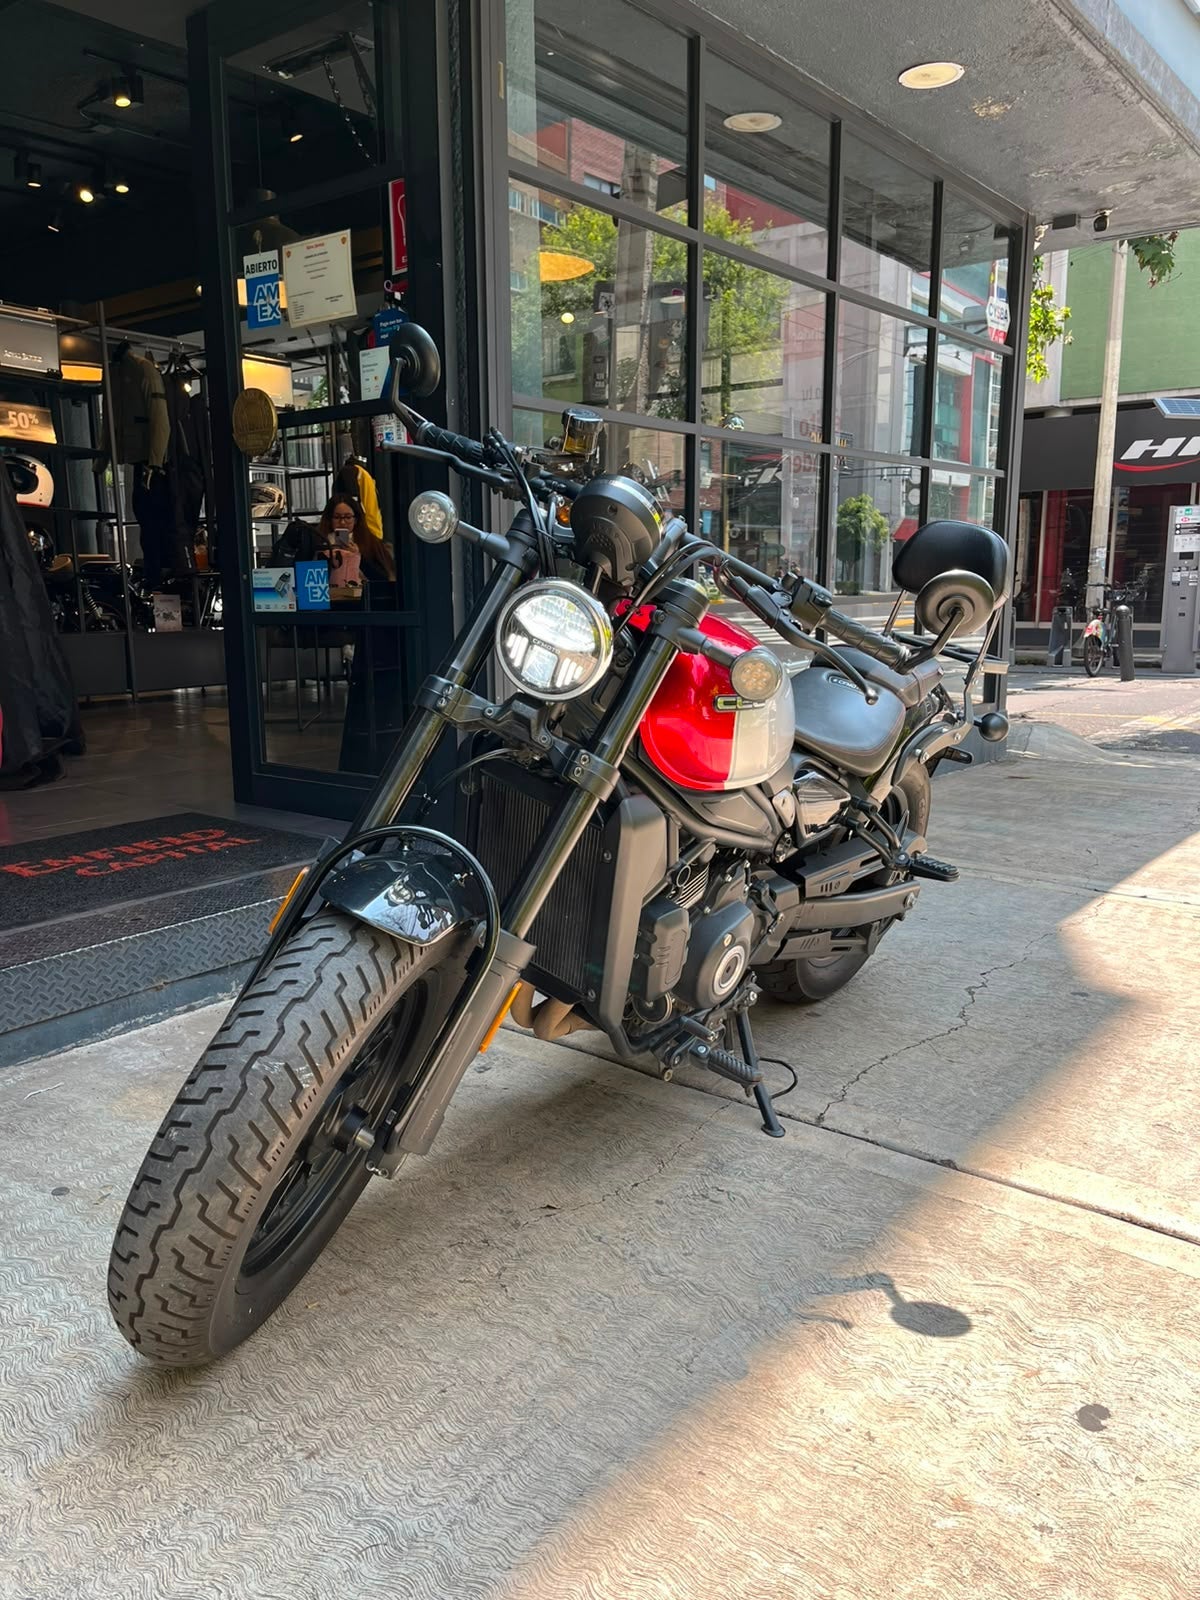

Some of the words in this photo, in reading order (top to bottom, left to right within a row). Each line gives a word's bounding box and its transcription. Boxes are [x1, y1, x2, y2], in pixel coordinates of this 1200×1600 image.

[245, 259, 278, 275] ABIERTO
[989, 303, 1008, 320] CYSBA
[8, 411, 39, 429] 50%
[75, 837, 260, 877] CAPITAL
